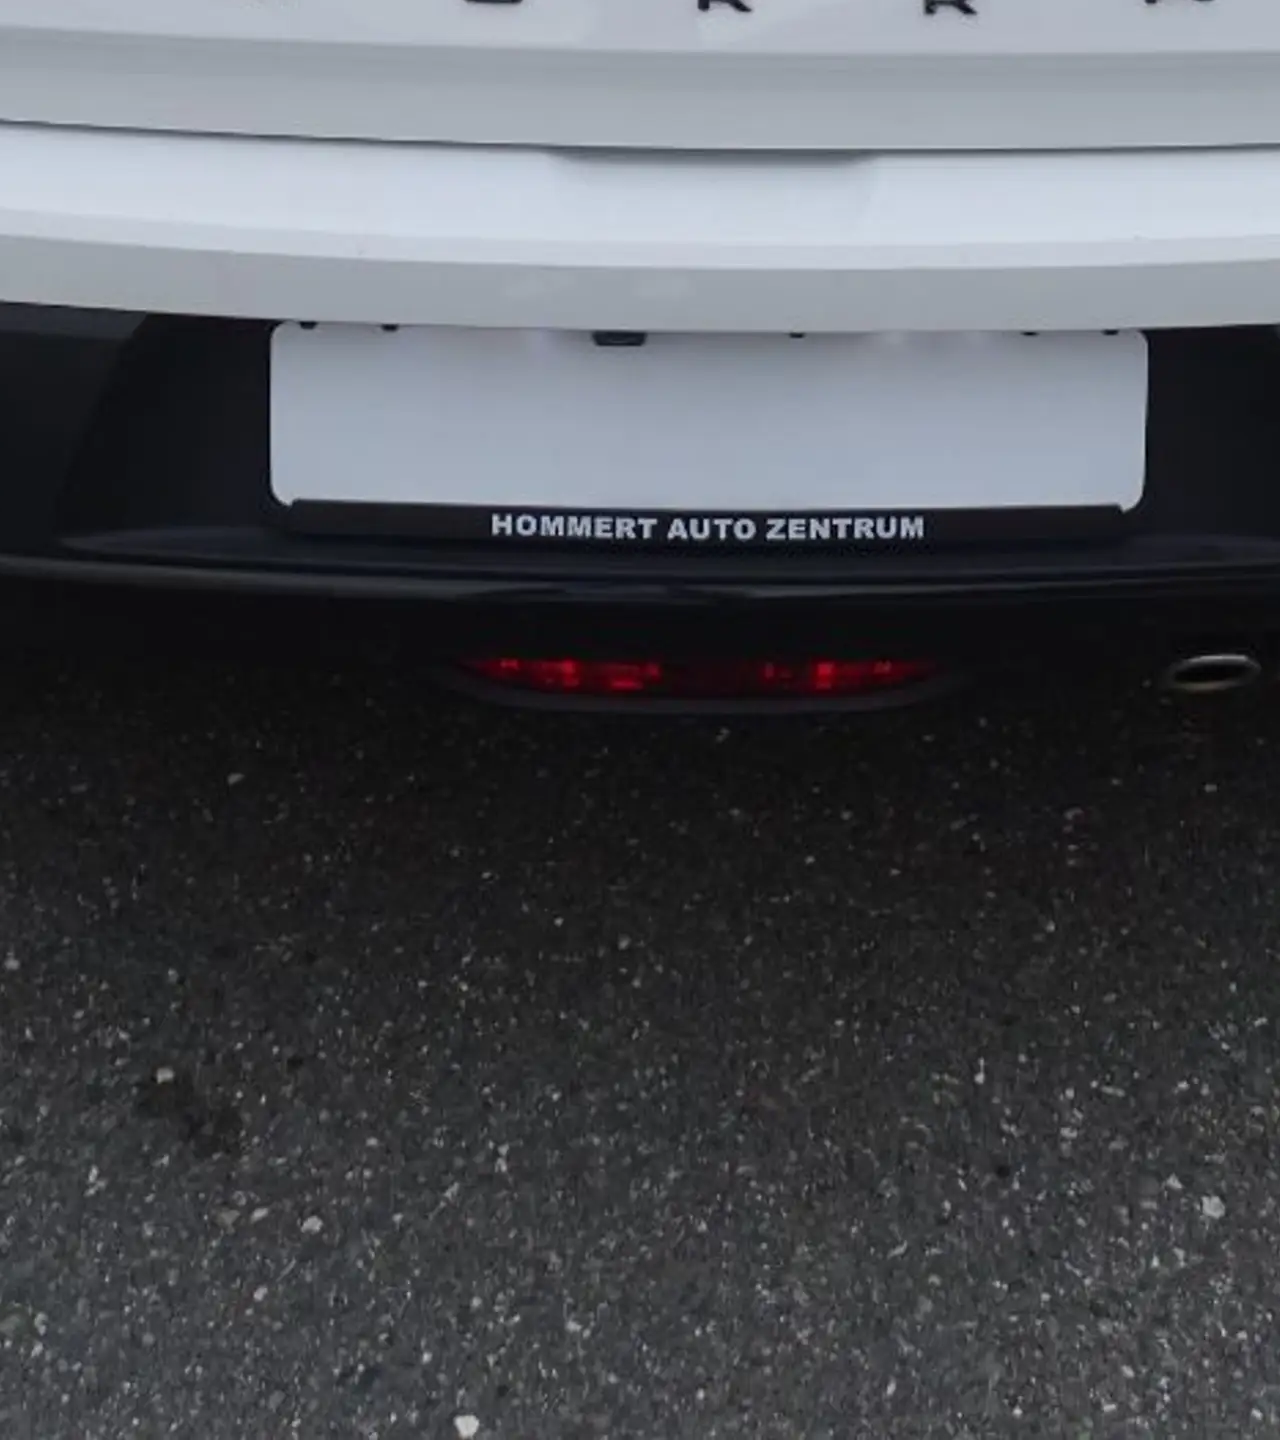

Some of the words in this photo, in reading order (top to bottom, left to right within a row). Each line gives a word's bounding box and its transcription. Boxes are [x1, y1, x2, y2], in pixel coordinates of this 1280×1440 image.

[491, 513, 658, 539] HOMMERT
[667, 517, 757, 541] AUTO
[766, 515, 925, 540] ZENTRUM
